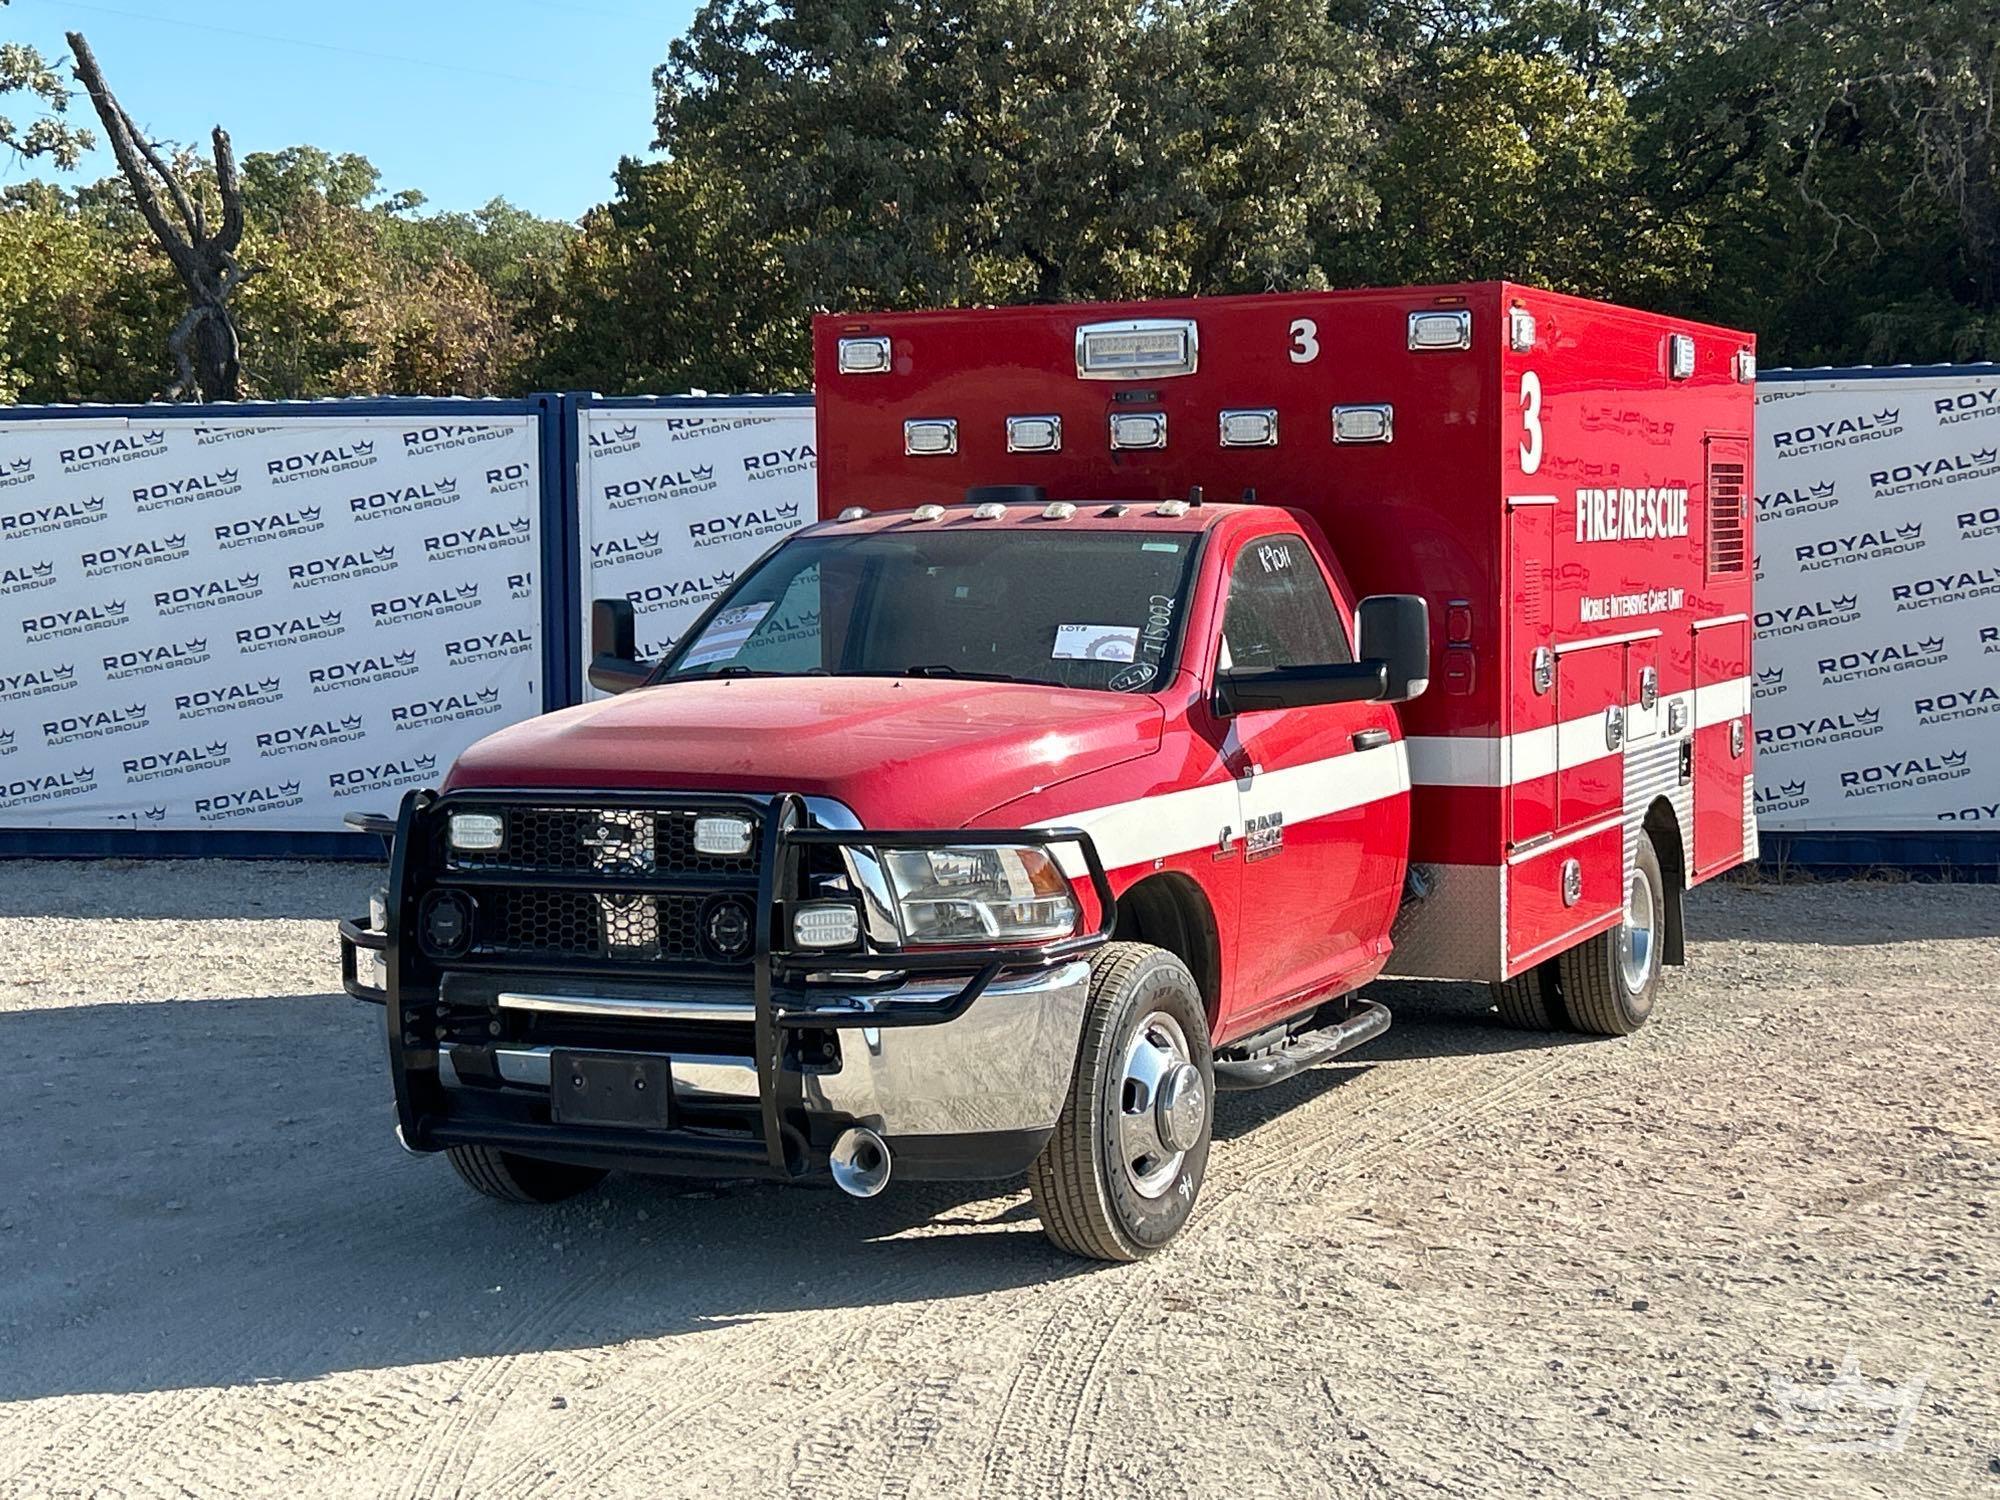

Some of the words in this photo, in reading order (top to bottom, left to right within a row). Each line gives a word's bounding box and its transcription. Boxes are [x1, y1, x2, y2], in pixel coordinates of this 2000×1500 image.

[1289, 318, 1320, 364] 3
[671, 422, 730, 441] AUCTION
[1520, 370, 1542, 475] 3
[1774, 416, 1873, 448] ROYAL
[60, 436, 143, 464] ROYAL
[198, 428, 255, 445] AUCTION
[407, 438, 465, 457] AUCTION
[468, 428, 514, 444] GROUP
[595, 442, 640, 458] GROUP
[1778, 438, 1846, 459] AUCTION
[1849, 426, 1903, 444] GROUP
[64, 457, 120, 474] AUCTION
[123, 446, 168, 462] GROUP
[267, 447, 353, 475] ROYAL
[272, 468, 329, 485] AUCTION
[332, 457, 378, 473] GROUP
[744, 445, 817, 471] ROYA
[1870, 456, 1971, 487] ROYAL
[748, 463, 807, 481] AUCTION
[1874, 478, 1944, 498] AUCTION
[1947, 466, 2000, 484] GROUP
[133, 475, 217, 503] ROYAL
[137, 496, 194, 513] AUCTION
[197, 485, 242, 501] GROUP
[350, 485, 435, 512] ROYAL
[605, 472, 692, 500] ROYAL
[609, 492, 668, 510] AUCTION
[671, 482, 717, 498] GROUP
[1, 503, 84, 530] ROYAL
[355, 505, 412, 522] AUCTION
[415, 494, 460, 510] GROUP
[1576, 488, 1688, 542] FIRE/RESCUE
[1785, 499, 1838, 516] GROUP
[6, 523, 61, 540] AUCTION
[64, 513, 108, 528] GROUP
[215, 513, 300, 540] ROYAL
[219, 533, 276, 550] AUCTION
[279, 522, 325, 538] GROUP
[690, 510, 776, 538] ROYAL
[694, 530, 752, 547] AUCTION
[755, 519, 801, 535] GROUP
[424, 524, 510, 552] ROYAL
[1796, 530, 1896, 561] ROYAL
[82, 540, 165, 568] ROYAL
[86, 560, 142, 578] AUCTION
[145, 550, 190, 566] GROUP
[289, 552, 374, 579] ROYAL
[429, 544, 486, 562] AUCTION
[617, 548, 662, 563] GROUP
[1800, 552, 1869, 572] AUCTION
[1872, 541, 1926, 558] GROUP
[12, 577, 57, 593] GROUP
[293, 572, 350, 589] AUCTION
[353, 562, 398, 577] GROUP
[1892, 570, 1993, 601] ROYAL
[154, 580, 238, 607] ROYAL
[159, 600, 215, 617] AUCTION
[218, 589, 263, 605] GROUP
[371, 590, 457, 617] ROYAL
[626, 578, 712, 604] ROYAL
[1896, 592, 1966, 612] AUCTION
[22, 607, 105, 633] ROYAL
[375, 610, 433, 627] AUCTION
[436, 600, 482, 615] GROUP
[1754, 602, 1831, 628] OYAL
[1807, 612, 1861, 630] GROUP
[26, 627, 82, 643] AUCTION
[85, 616, 129, 632] GROUP
[236, 617, 320, 644] ROYAL
[240, 637, 297, 654] AUCTION
[300, 627, 345, 642] GROUP
[445, 629, 531, 656] ROYAL
[103, 644, 186, 671] ROYAL
[107, 664, 163, 681] AUCTION
[166, 654, 211, 669] GROUP
[309, 657, 394, 684] ROYAL
[449, 648, 507, 666] AUCTION
[1818, 644, 1918, 674] ROYAL
[1822, 666, 1891, 685] AUCTION
[1894, 654, 1948, 672] GROUP
[34, 680, 78, 696] GROUP
[314, 677, 370, 694] AUCTION
[374, 666, 419, 682] GROUP
[175, 684, 259, 710] ROYAL
[179, 704, 236, 720] AUCTION
[239, 693, 283, 708] GROUP
[392, 694, 477, 721] ROYAL
[43, 710, 126, 736] ROYAL
[396, 714, 453, 731] AUCTION
[456, 704, 502, 719] GROUP
[1919, 706, 1989, 725] AUCTION
[47, 730, 103, 746] AUCTION
[106, 720, 150, 735] GROUP
[256, 722, 341, 748] ROYAL
[1755, 715, 1854, 744] ROYAL
[1759, 736, 1827, 755] AUCTION
[1830, 726, 1883, 742] GROUP
[261, 741, 317, 758] AUCTION
[320, 731, 366, 746] GROUP
[123, 748, 206, 774] ROYAL
[127, 768, 183, 784] AUCTION
[186, 758, 231, 772] GROUP
[330, 760, 414, 788] ROYAL
[1840, 758, 1941, 787] ROYAL
[54, 783, 98, 798] GROUP
[333, 780, 391, 798] AUCTION
[394, 770, 439, 786] GROUP
[1844, 779, 1914, 798] AUCTION
[1917, 768, 1971, 785] GROUP
[195, 787, 279, 813] ROYAL
[199, 807, 255, 823] AUCTION
[259, 797, 303, 812] GROUP
[1756, 798, 1809, 815] GROUP
